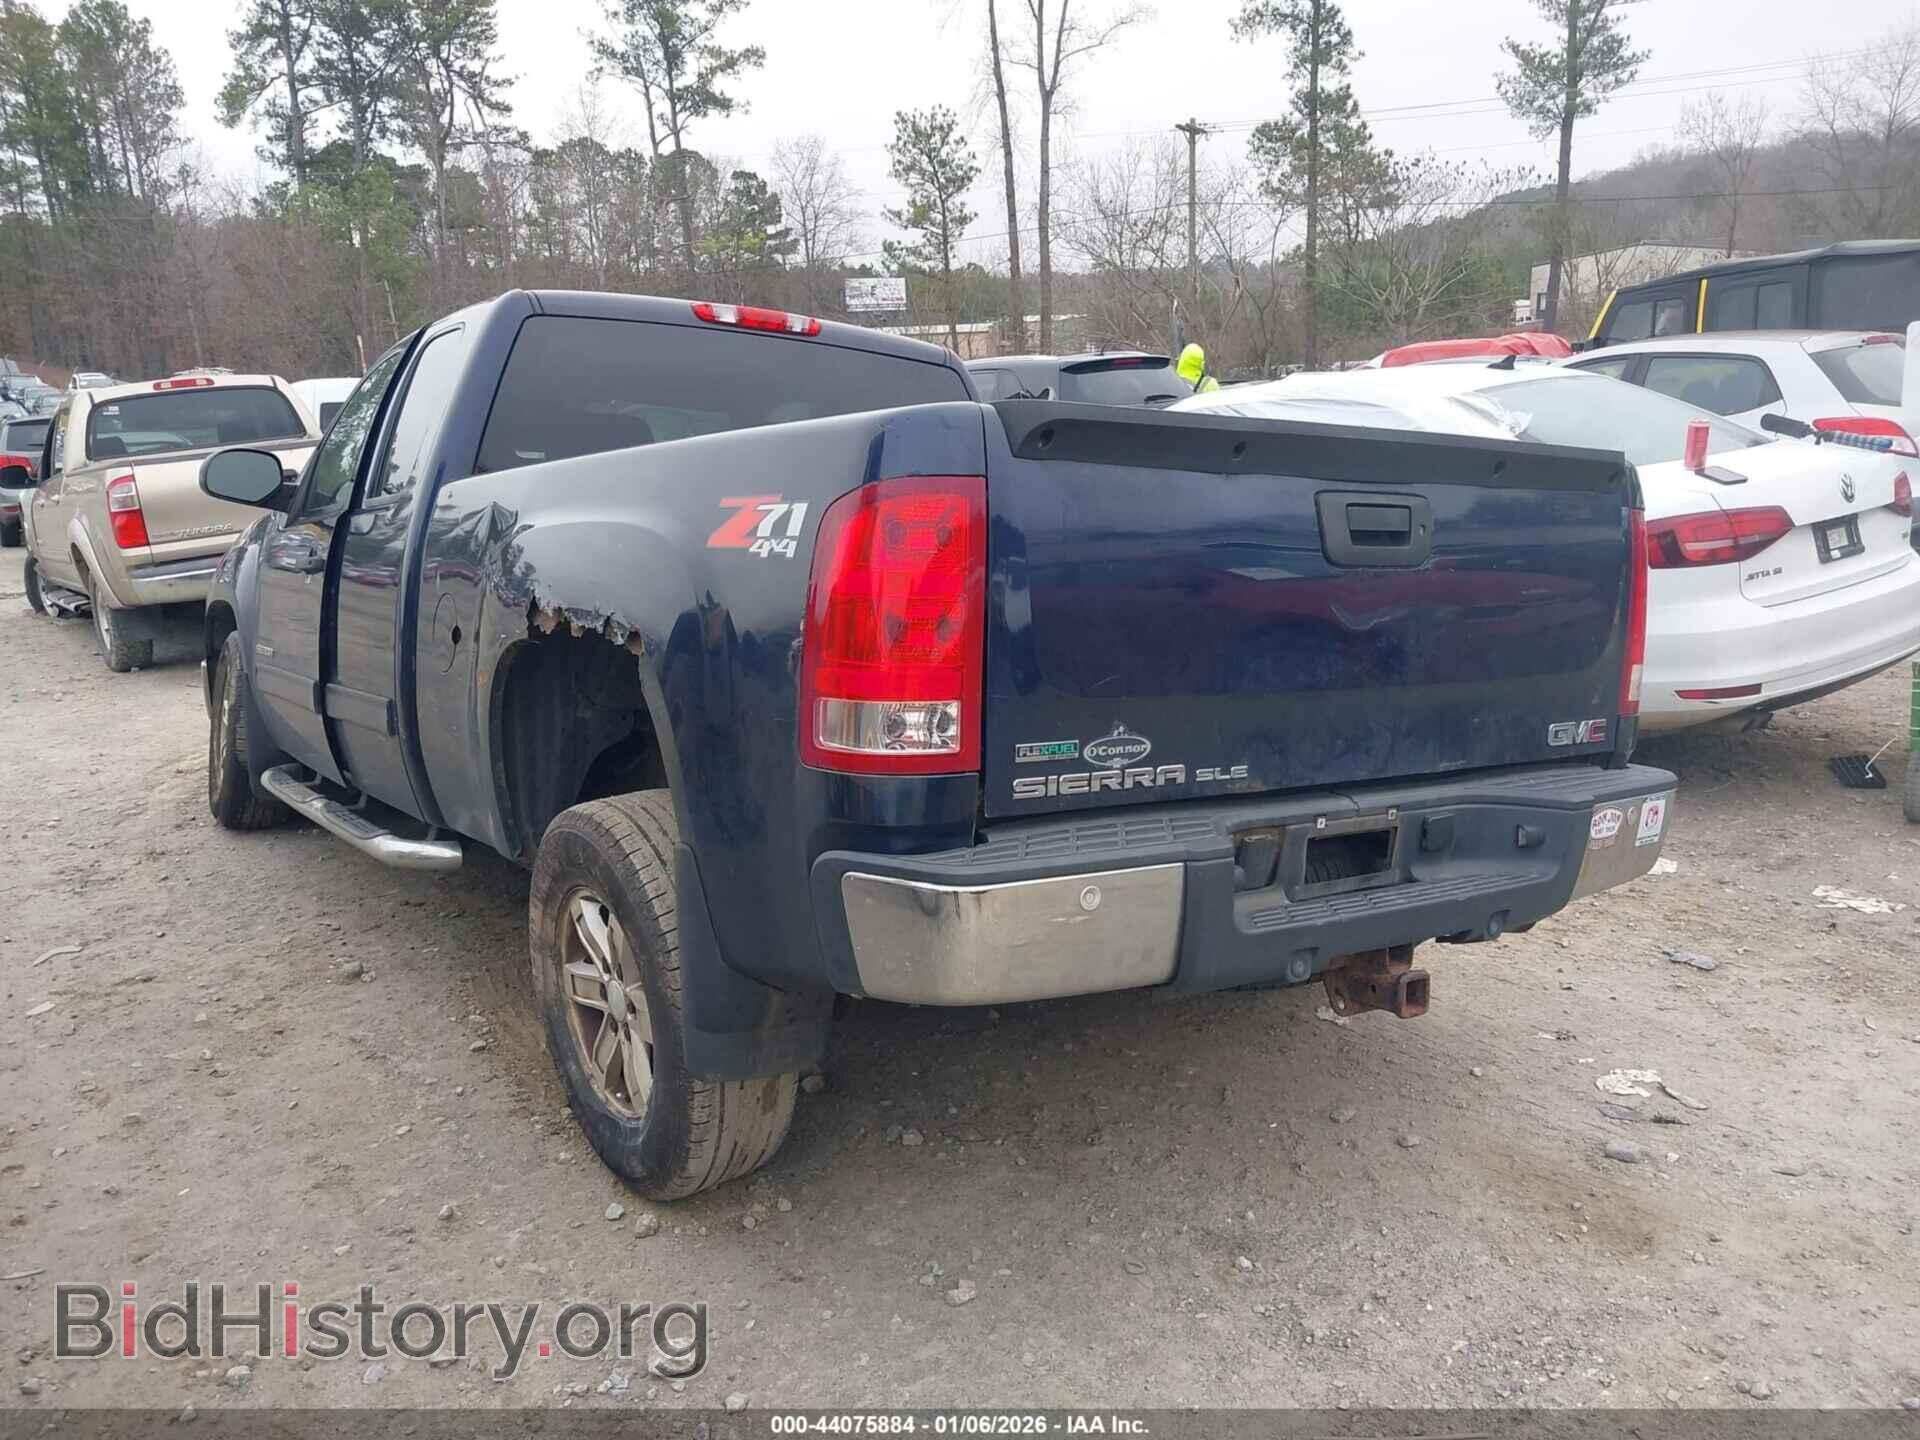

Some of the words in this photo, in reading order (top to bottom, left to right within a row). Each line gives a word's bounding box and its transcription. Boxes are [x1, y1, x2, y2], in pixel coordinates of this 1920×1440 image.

[706, 495, 809, 548] Z71
[1548, 719, 1607, 747] GMC
[1087, 743, 1148, 757] O'Connor
[1012, 763, 1186, 800] SIERRA
[1195, 764, 1249, 783] SLE
